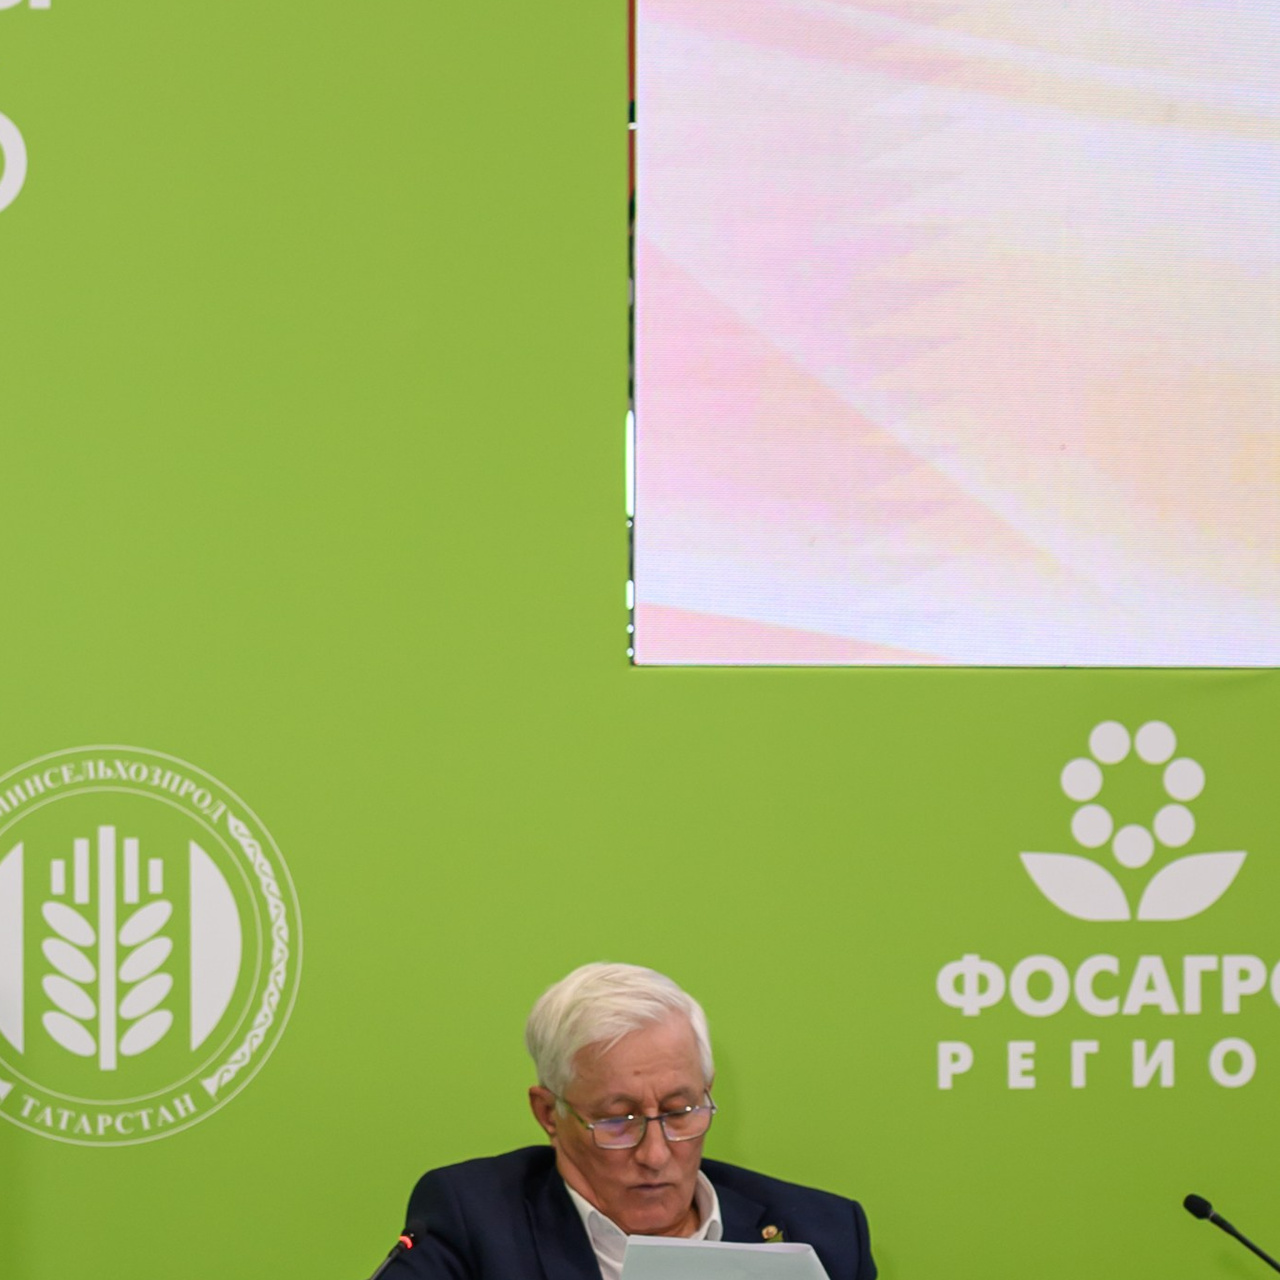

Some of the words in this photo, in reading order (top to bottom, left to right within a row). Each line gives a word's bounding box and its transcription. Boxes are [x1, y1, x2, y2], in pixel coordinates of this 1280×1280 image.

[935, 953, 1280, 1018] ФОСАГР
[937, 1037, 1257, 1090] РЕГИО
[20, 1093, 199, 1136] ТАТАРСТАН
